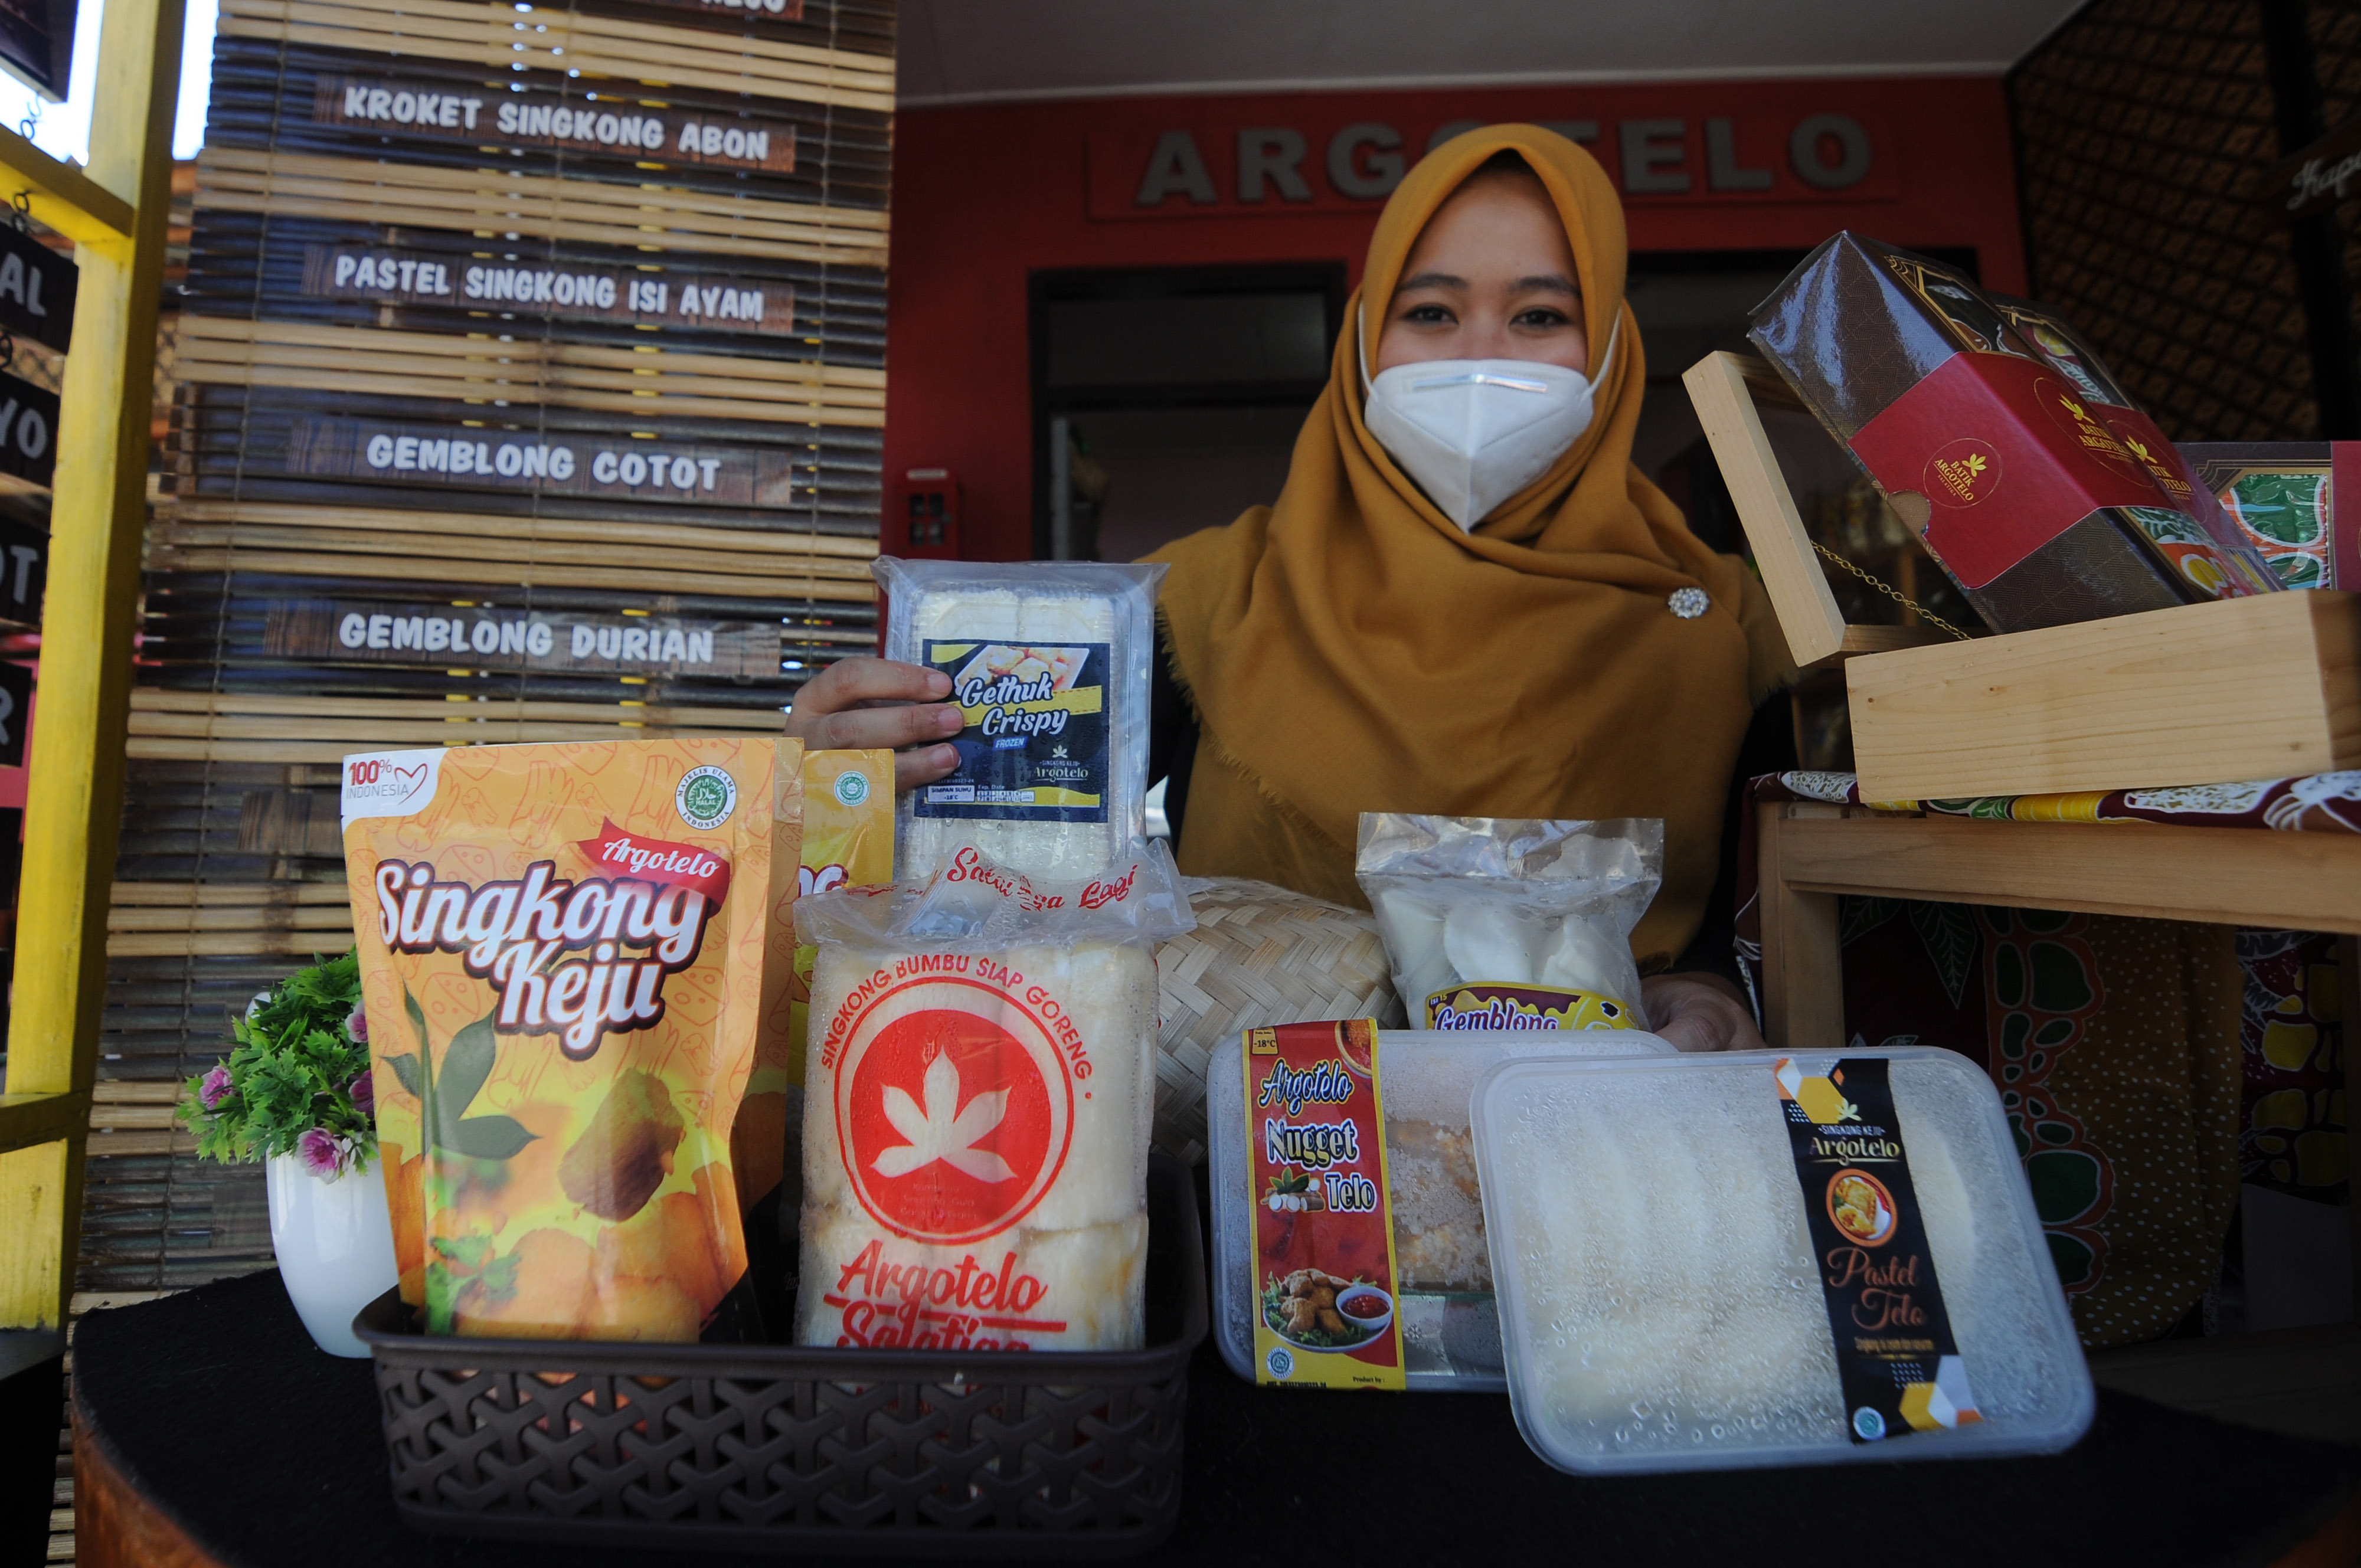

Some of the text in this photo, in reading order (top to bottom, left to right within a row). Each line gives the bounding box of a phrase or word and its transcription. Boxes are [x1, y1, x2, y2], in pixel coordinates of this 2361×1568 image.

[344, 87, 770, 161] KROKET SINGKONG ABON
[1134, 113, 1875, 207] ARGELO
[335, 254, 764, 322] PASTEL SINGKONG ISI AYAM
[366, 434, 721, 491] GEMBLONG COTOT
[1935, 459, 1974, 500] ARGOTELO
[1950, 461, 1975, 487] BATIK
[2147, 465, 2173, 478] TIK
[1938, 474, 1957, 496] SALATIGA
[339, 613, 714, 663] GEMBLONG DURIAN
[960, 672, 1054, 708] Gethuk
[982, 708, 1070, 738] Crispy
[995, 738, 1025, 748] FROZEN
[346, 784, 409, 800] INDONESIA
[347, 759, 393, 787] 100%
[678, 768, 735, 797] MAJELIS ULAMA
[1034, 767, 1088, 783] Argotelo
[682, 811, 730, 828] INDONESIA
[601, 837, 720, 878] Argotelo
[1078, 864, 1138, 909] Lagi
[495, 938, 661, 1052] Keju
[822, 954, 1093, 1080] SINGKONG BUMBU SIAP GORENG
[1258, 1060, 1353, 1115] Argotelo
[1267, 1121, 1358, 1168] Nugget
[1821, 1124, 1862, 1136] SINGKONG
[1809, 1137, 1900, 1166] Argotelo
[1326, 1174, 1375, 1211] Telo
[837, 1239, 1048, 1324] Argotelo
[1827, 1247, 1918, 1288] Pastel
[836, 1301, 1030, 1351] Salati
